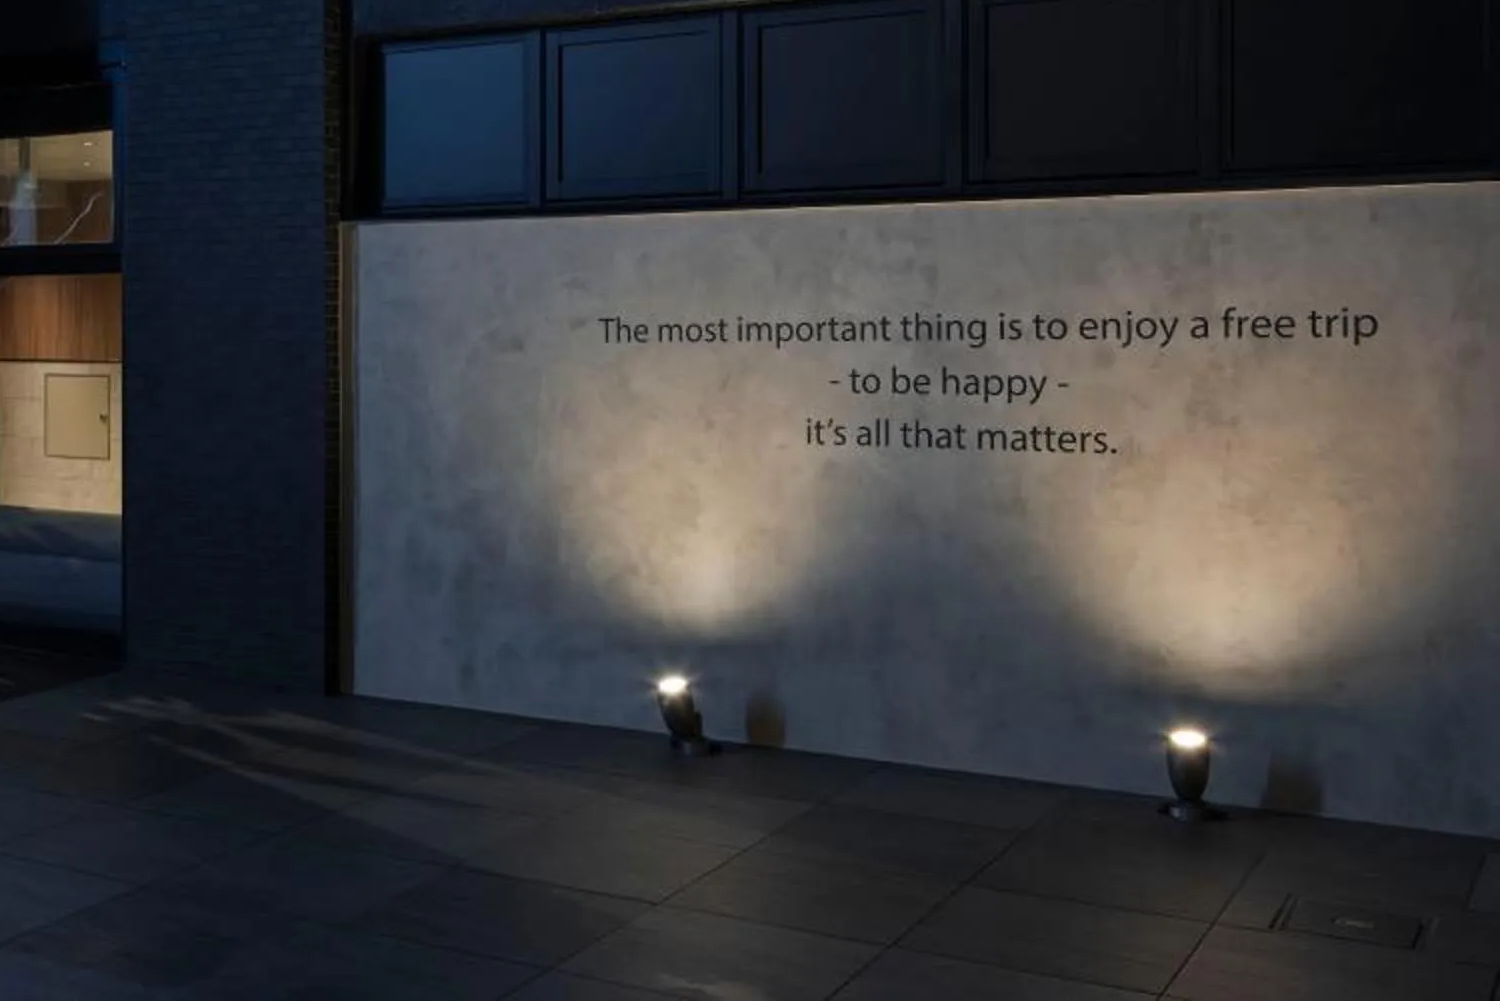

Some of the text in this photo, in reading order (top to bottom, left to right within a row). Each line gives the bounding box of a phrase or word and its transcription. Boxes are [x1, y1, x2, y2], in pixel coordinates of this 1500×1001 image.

[598, 306, 1379, 350] The most important thing is to enjoy a free trip
[848, 368, 882, 395] to
[891, 365, 931, 396] be
[941, 365, 1048, 404] happy
[856, 417, 890, 448] all
[899, 418, 967, 451] that
[977, 425, 1118, 455] matters.
